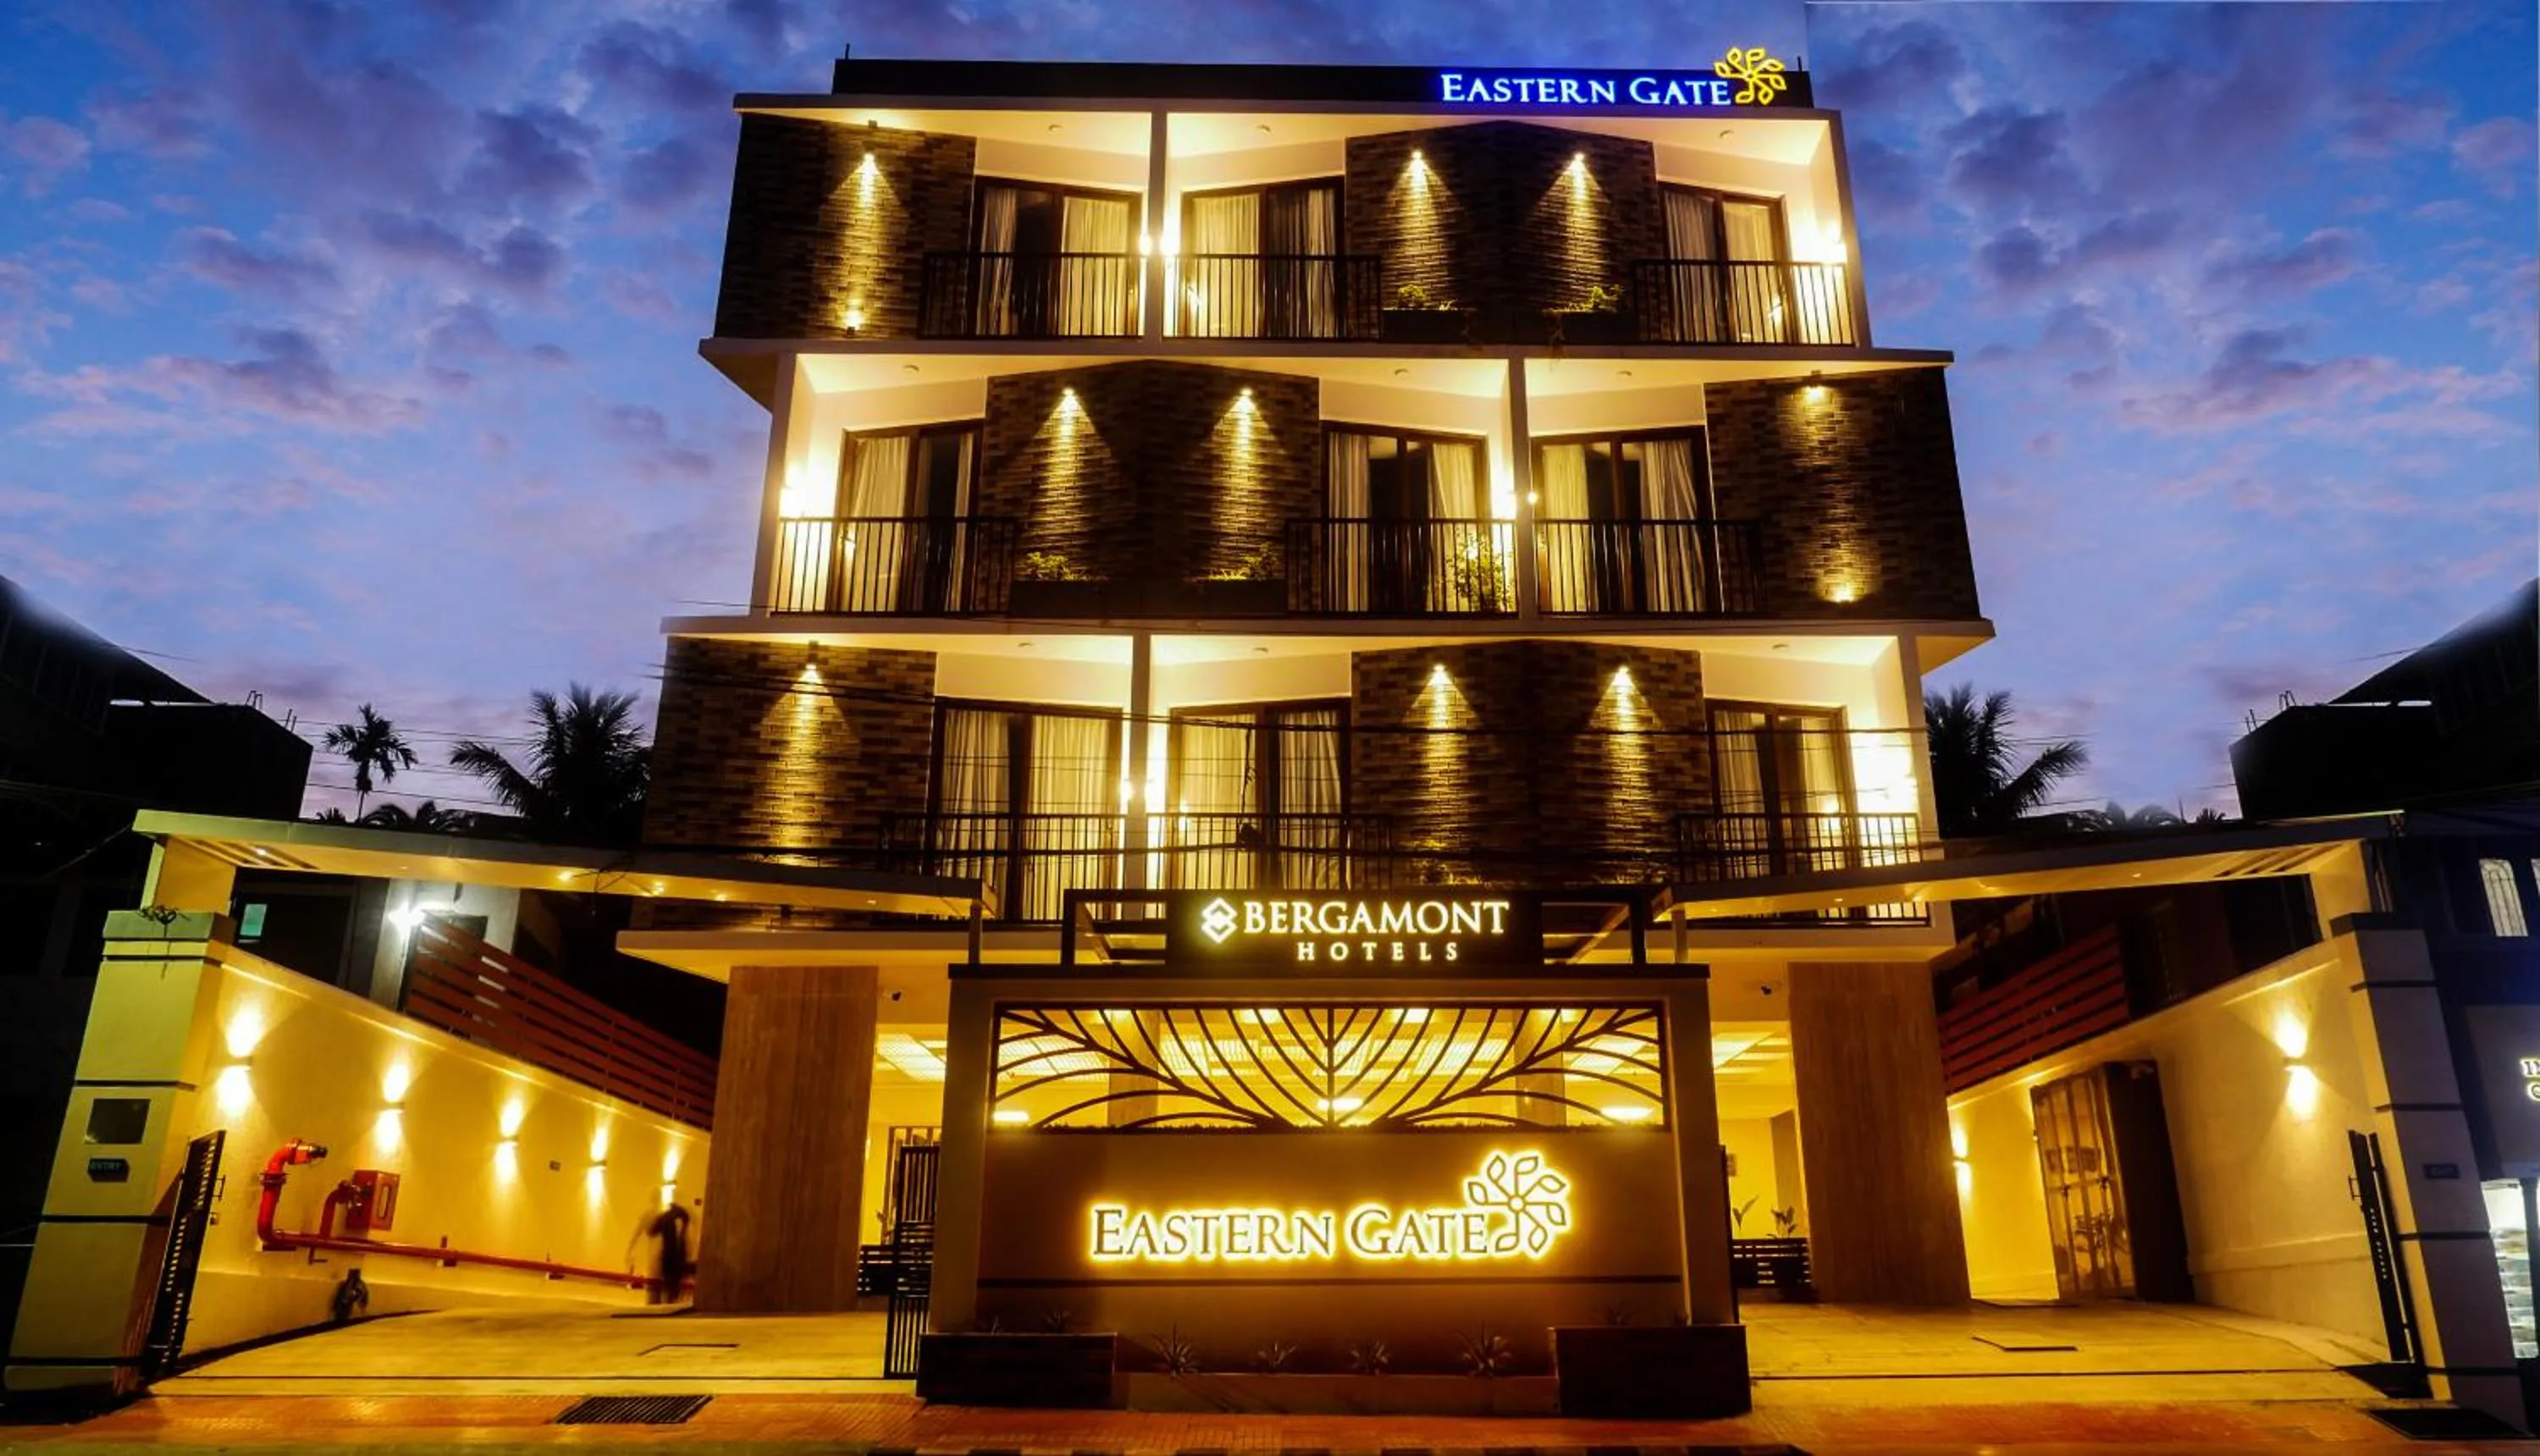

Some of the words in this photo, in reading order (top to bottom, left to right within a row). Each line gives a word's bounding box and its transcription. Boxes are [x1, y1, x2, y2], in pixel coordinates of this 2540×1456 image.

[1441, 74, 1615, 103] EASTERN
[1631, 77, 1731, 105] GATE
[1243, 902, 1510, 934] BERGAMONT
[1297, 942, 1458, 961] HOTELS
[1093, 1209, 1332, 1255] EASTERN
[1350, 1210, 1488, 1254] GATE
